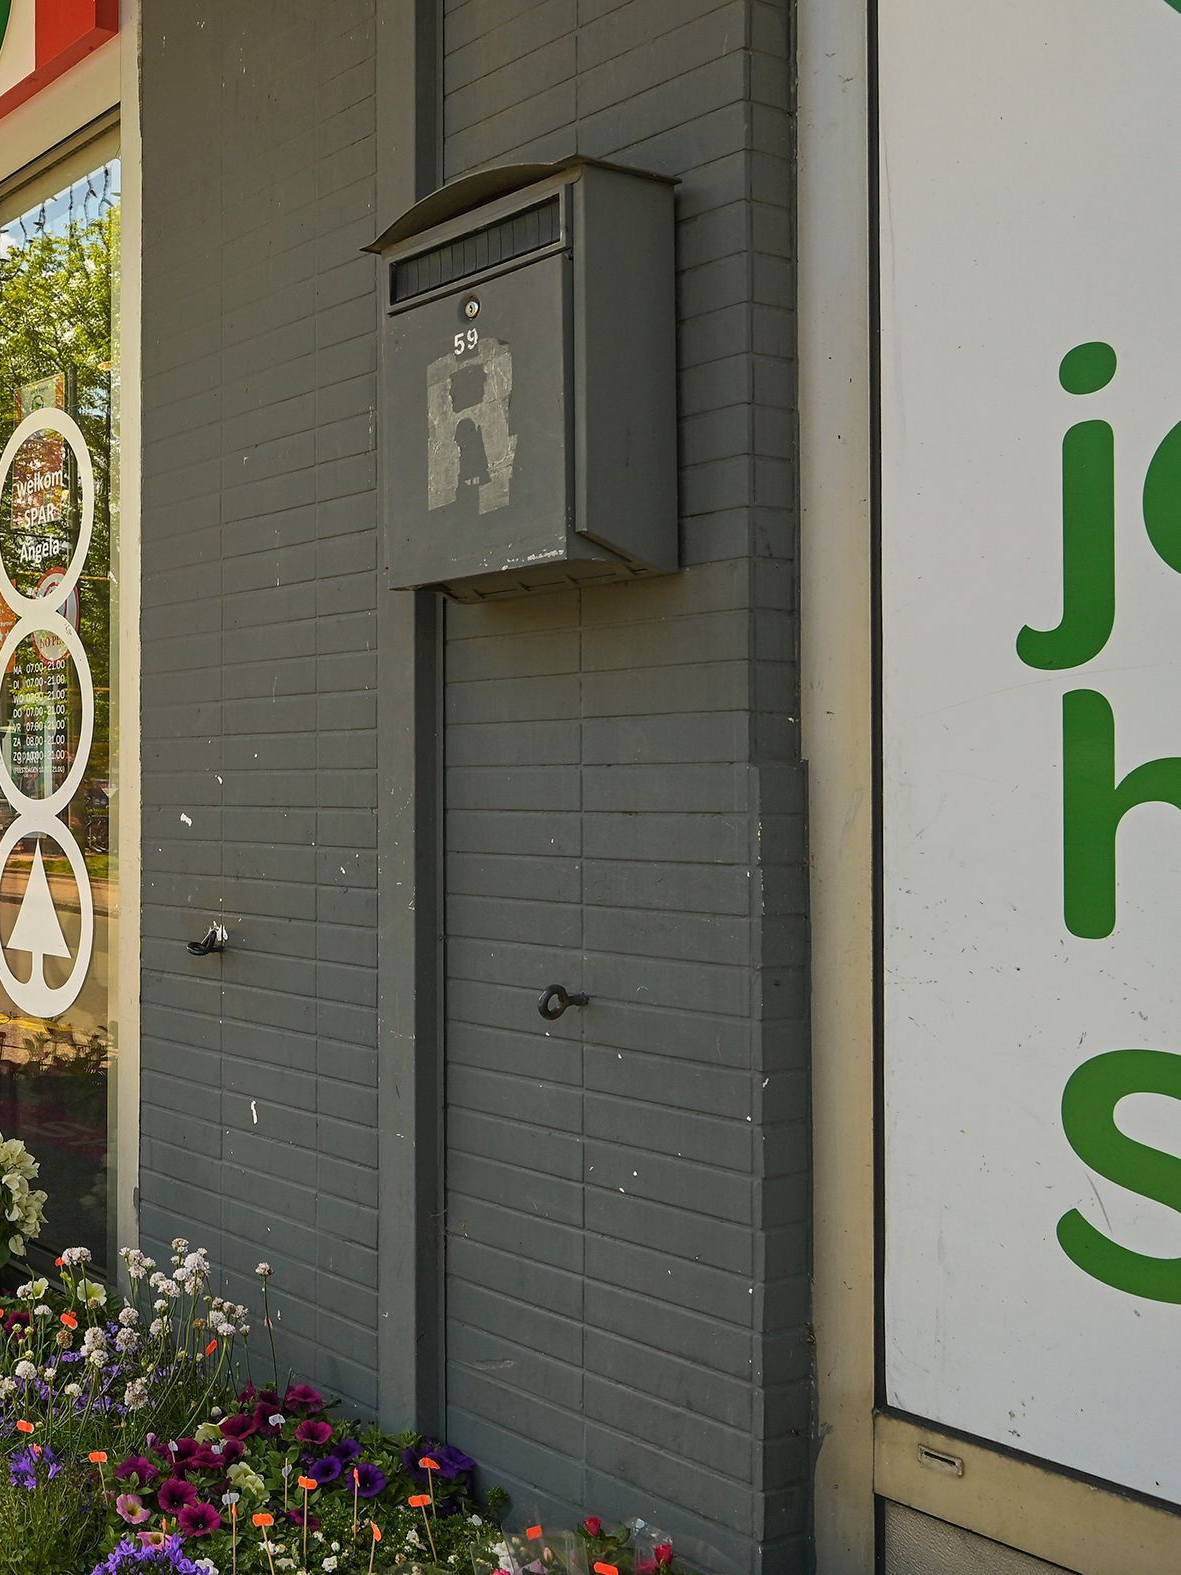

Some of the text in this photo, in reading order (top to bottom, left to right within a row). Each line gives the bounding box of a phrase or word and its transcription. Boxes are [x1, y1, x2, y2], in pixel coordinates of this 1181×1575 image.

[454, 328, 478, 355] 59
[17, 470, 63, 497] welkom
[24, 502, 55, 529] SPAR
[20, 536, 60, 564] Angela
[13, 665, 22, 674] MA
[13, 680, 20, 690] DI
[13, 708, 22, 718] DO
[13, 737, 22, 747] ZA
